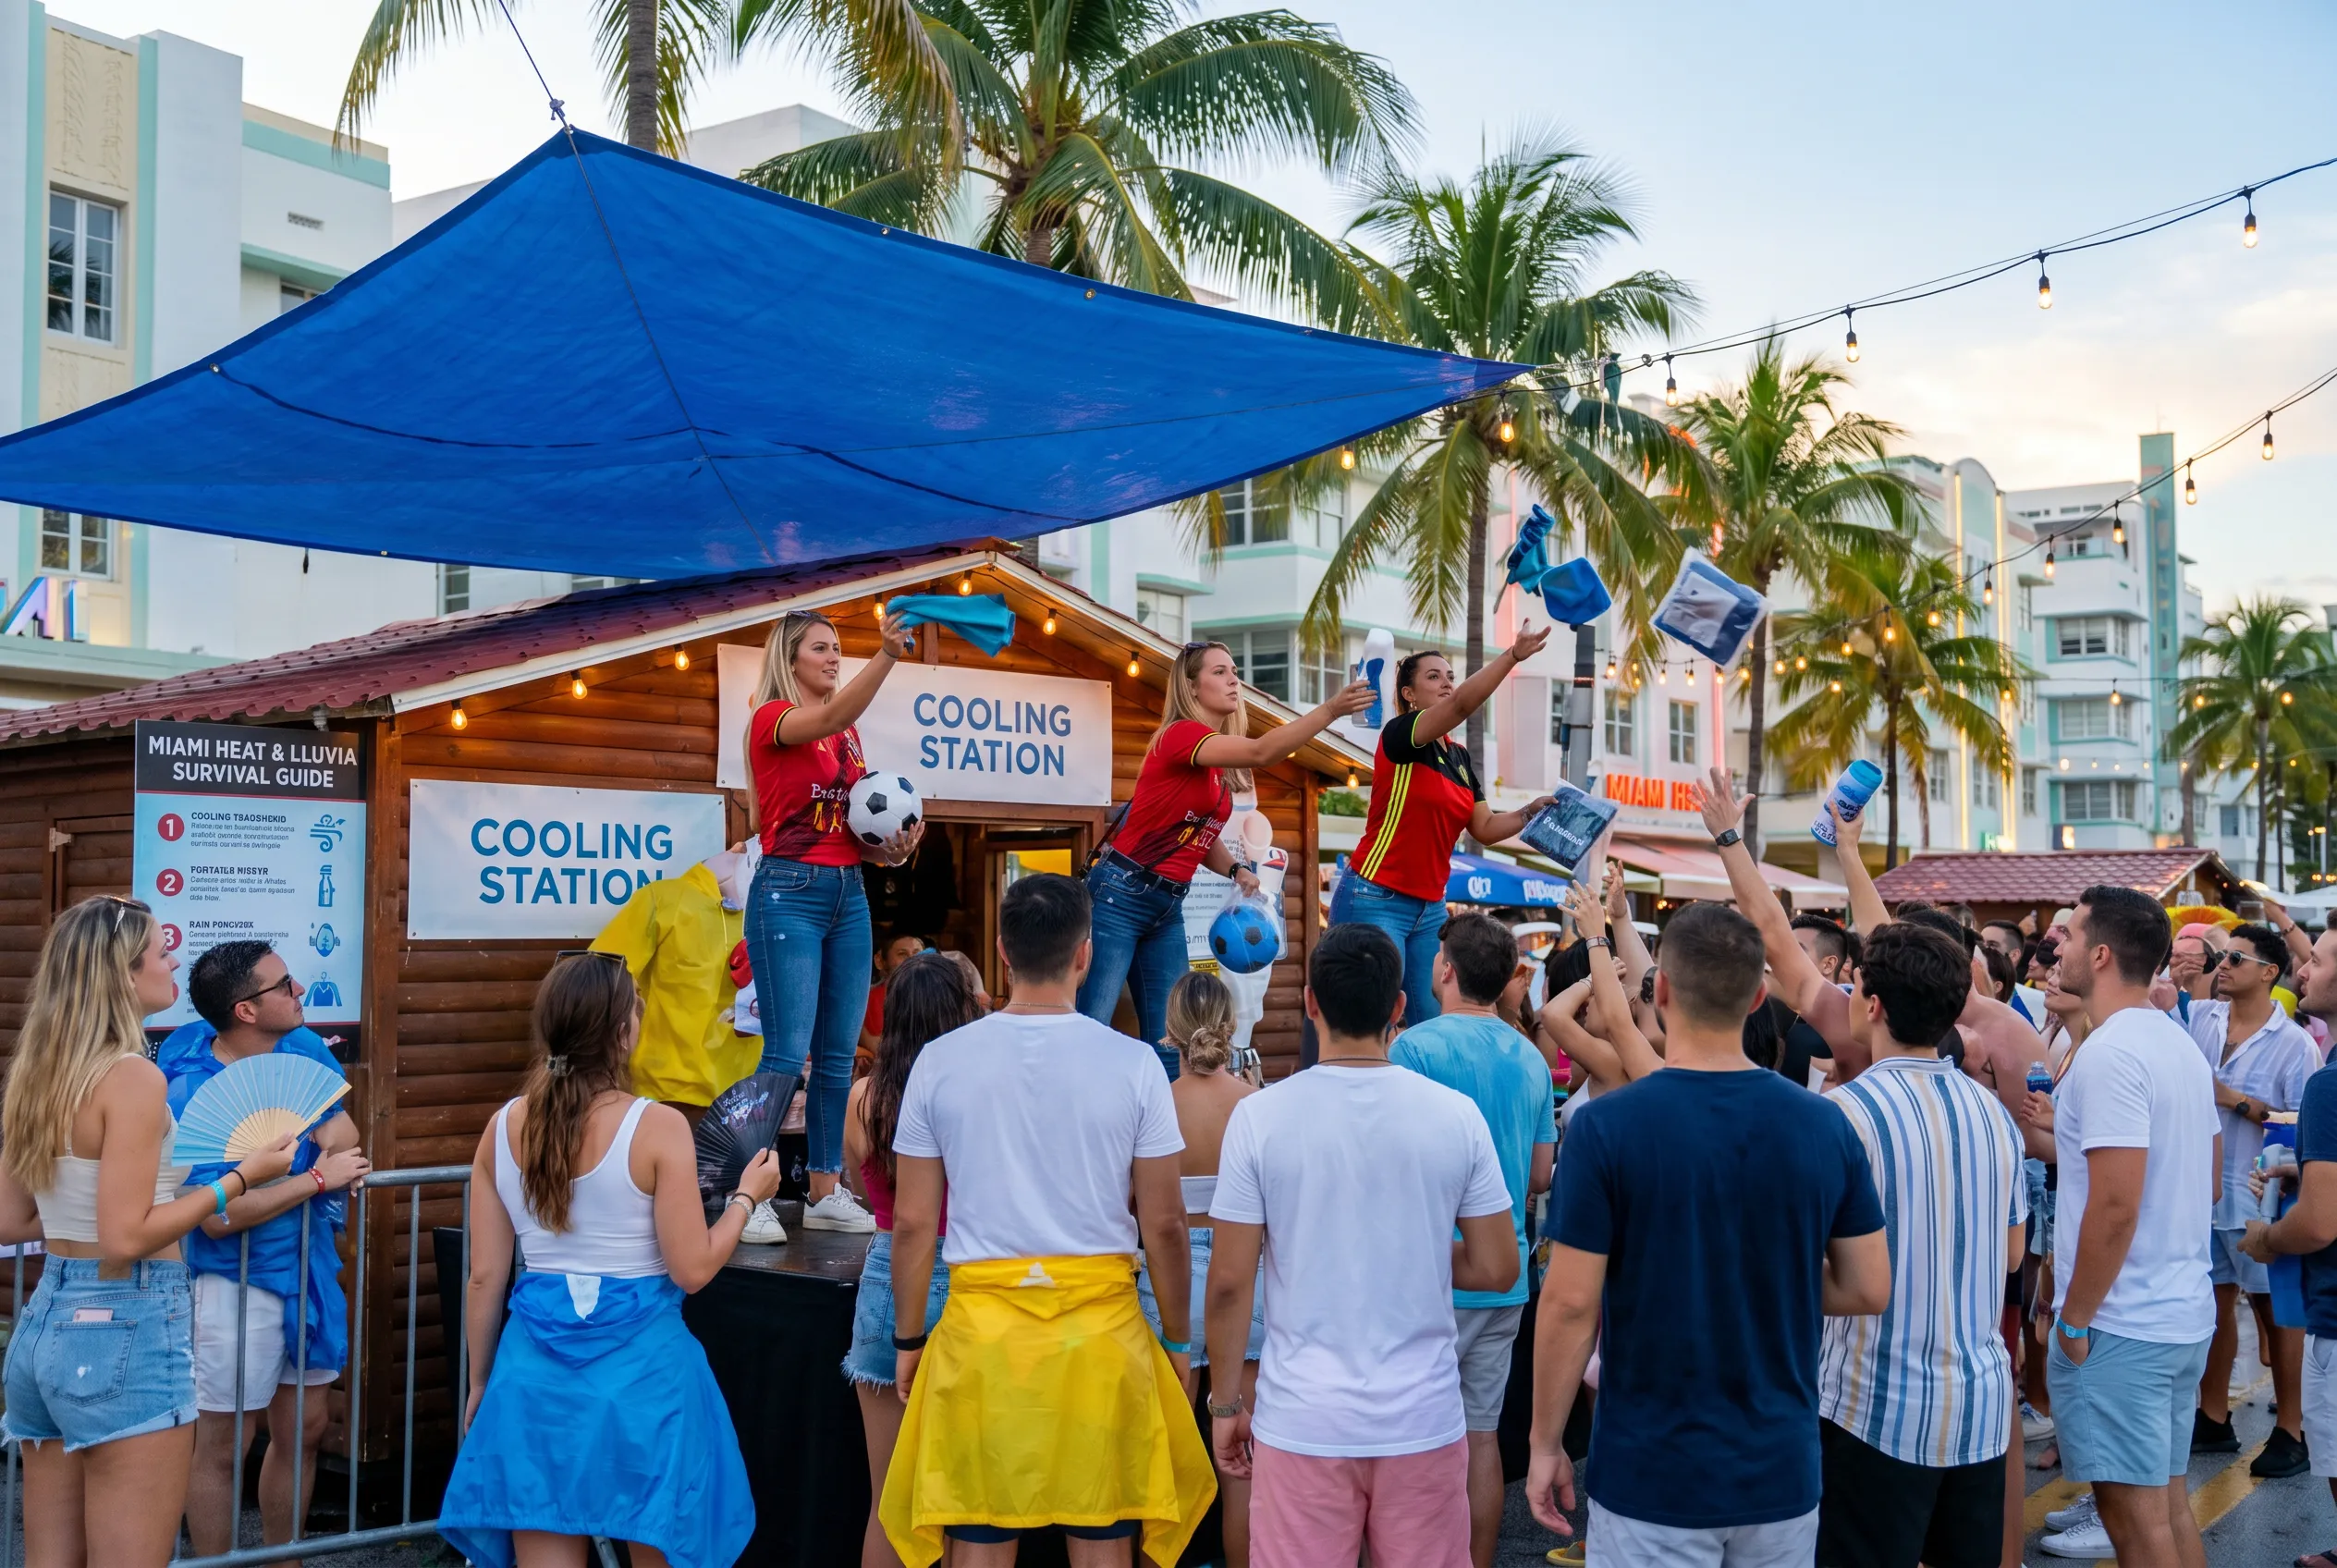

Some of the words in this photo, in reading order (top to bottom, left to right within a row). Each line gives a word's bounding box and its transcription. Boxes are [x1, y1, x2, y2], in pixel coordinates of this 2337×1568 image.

[913, 692, 1071, 737] COOLING
[149, 735, 209, 757] MIAMI
[215, 740, 266, 761] HEAT
[271, 743, 284, 762] &
[290, 744, 358, 766] LLUVIA
[920, 735, 1064, 777] STATION
[172, 762, 270, 784] SURVIVAL
[275, 767, 334, 788] GUIDE
[165, 818, 174, 837] 1
[191, 812, 231, 821] COOLING
[471, 817, 673, 861] COOLING
[164, 874, 176, 892] 2
[163, 927, 175, 947] 3
[190, 920, 210, 928] RAIN
